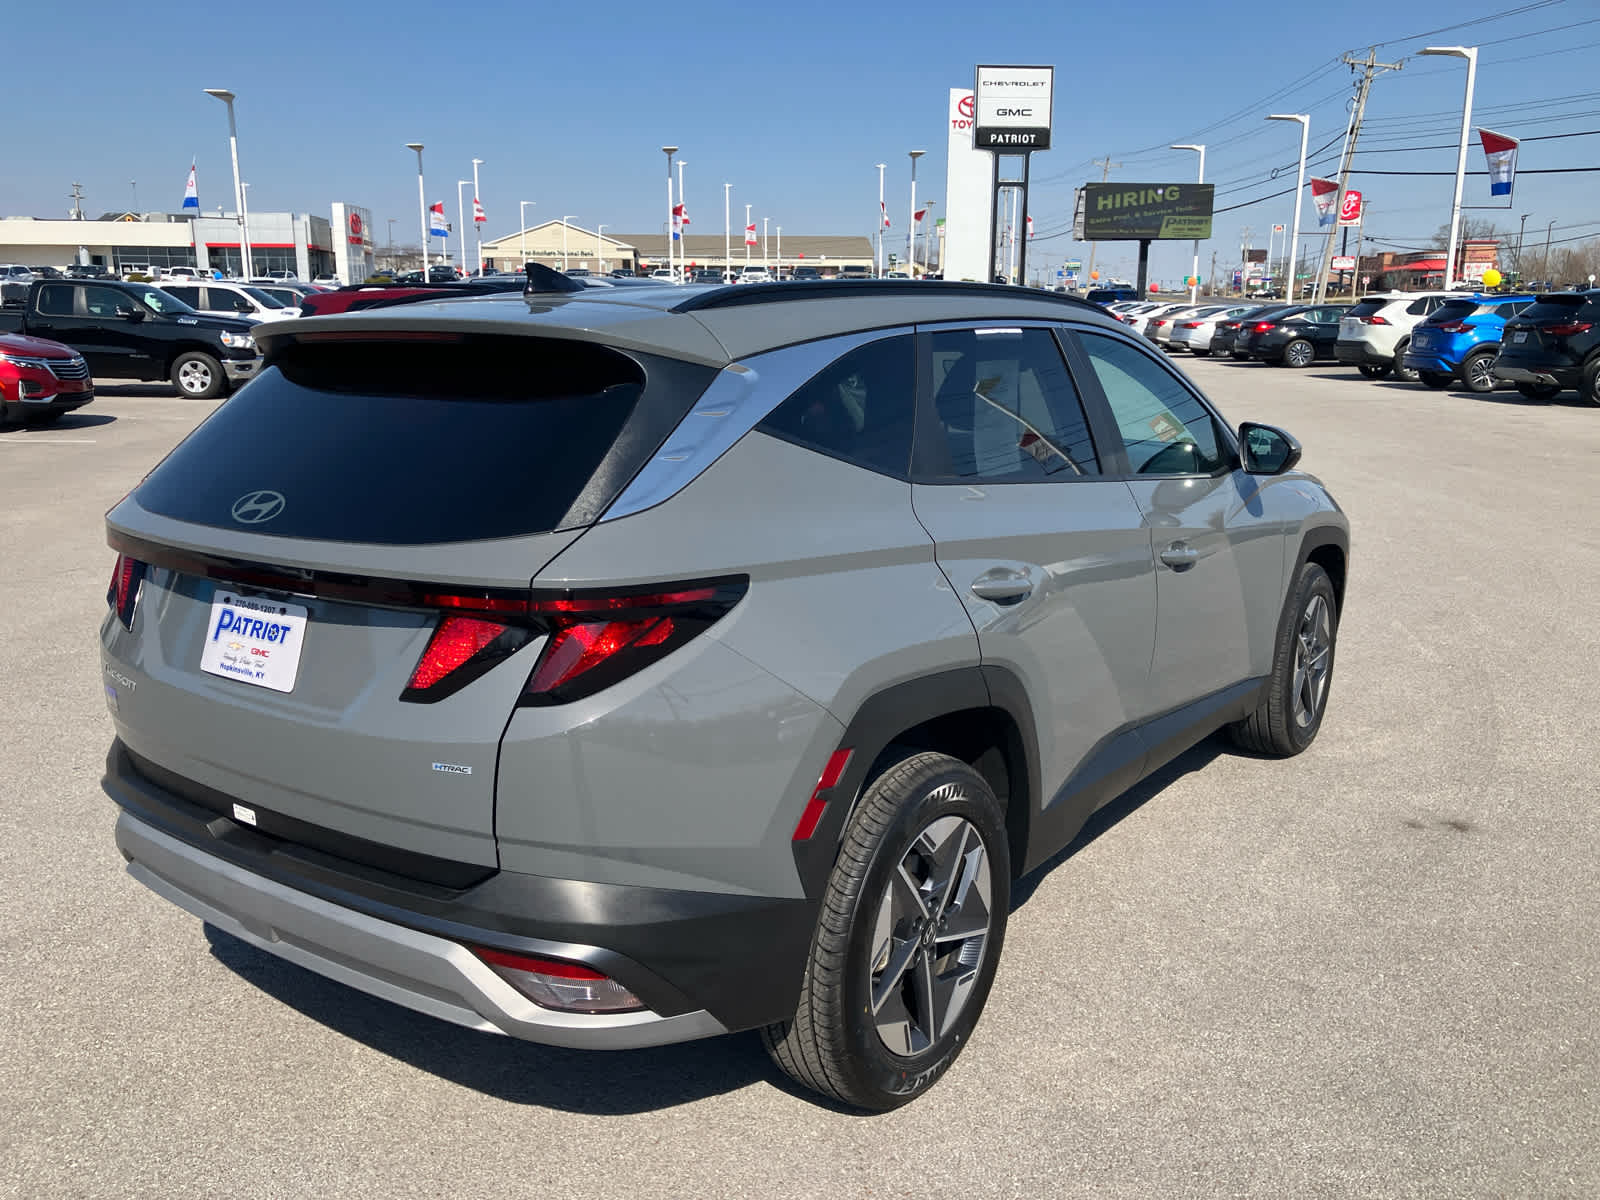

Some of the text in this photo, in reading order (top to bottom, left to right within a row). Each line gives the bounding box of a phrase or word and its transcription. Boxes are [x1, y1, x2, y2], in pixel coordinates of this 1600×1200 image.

[996, 108, 1033, 117] GMC
[990, 133, 1036, 144] PATRIOT
[1097, 185, 1181, 211] HIRING
[213, 607, 292, 645] PATRIOT
[250, 647, 271, 658] GMC
[434, 763, 469, 774] HTRAC
